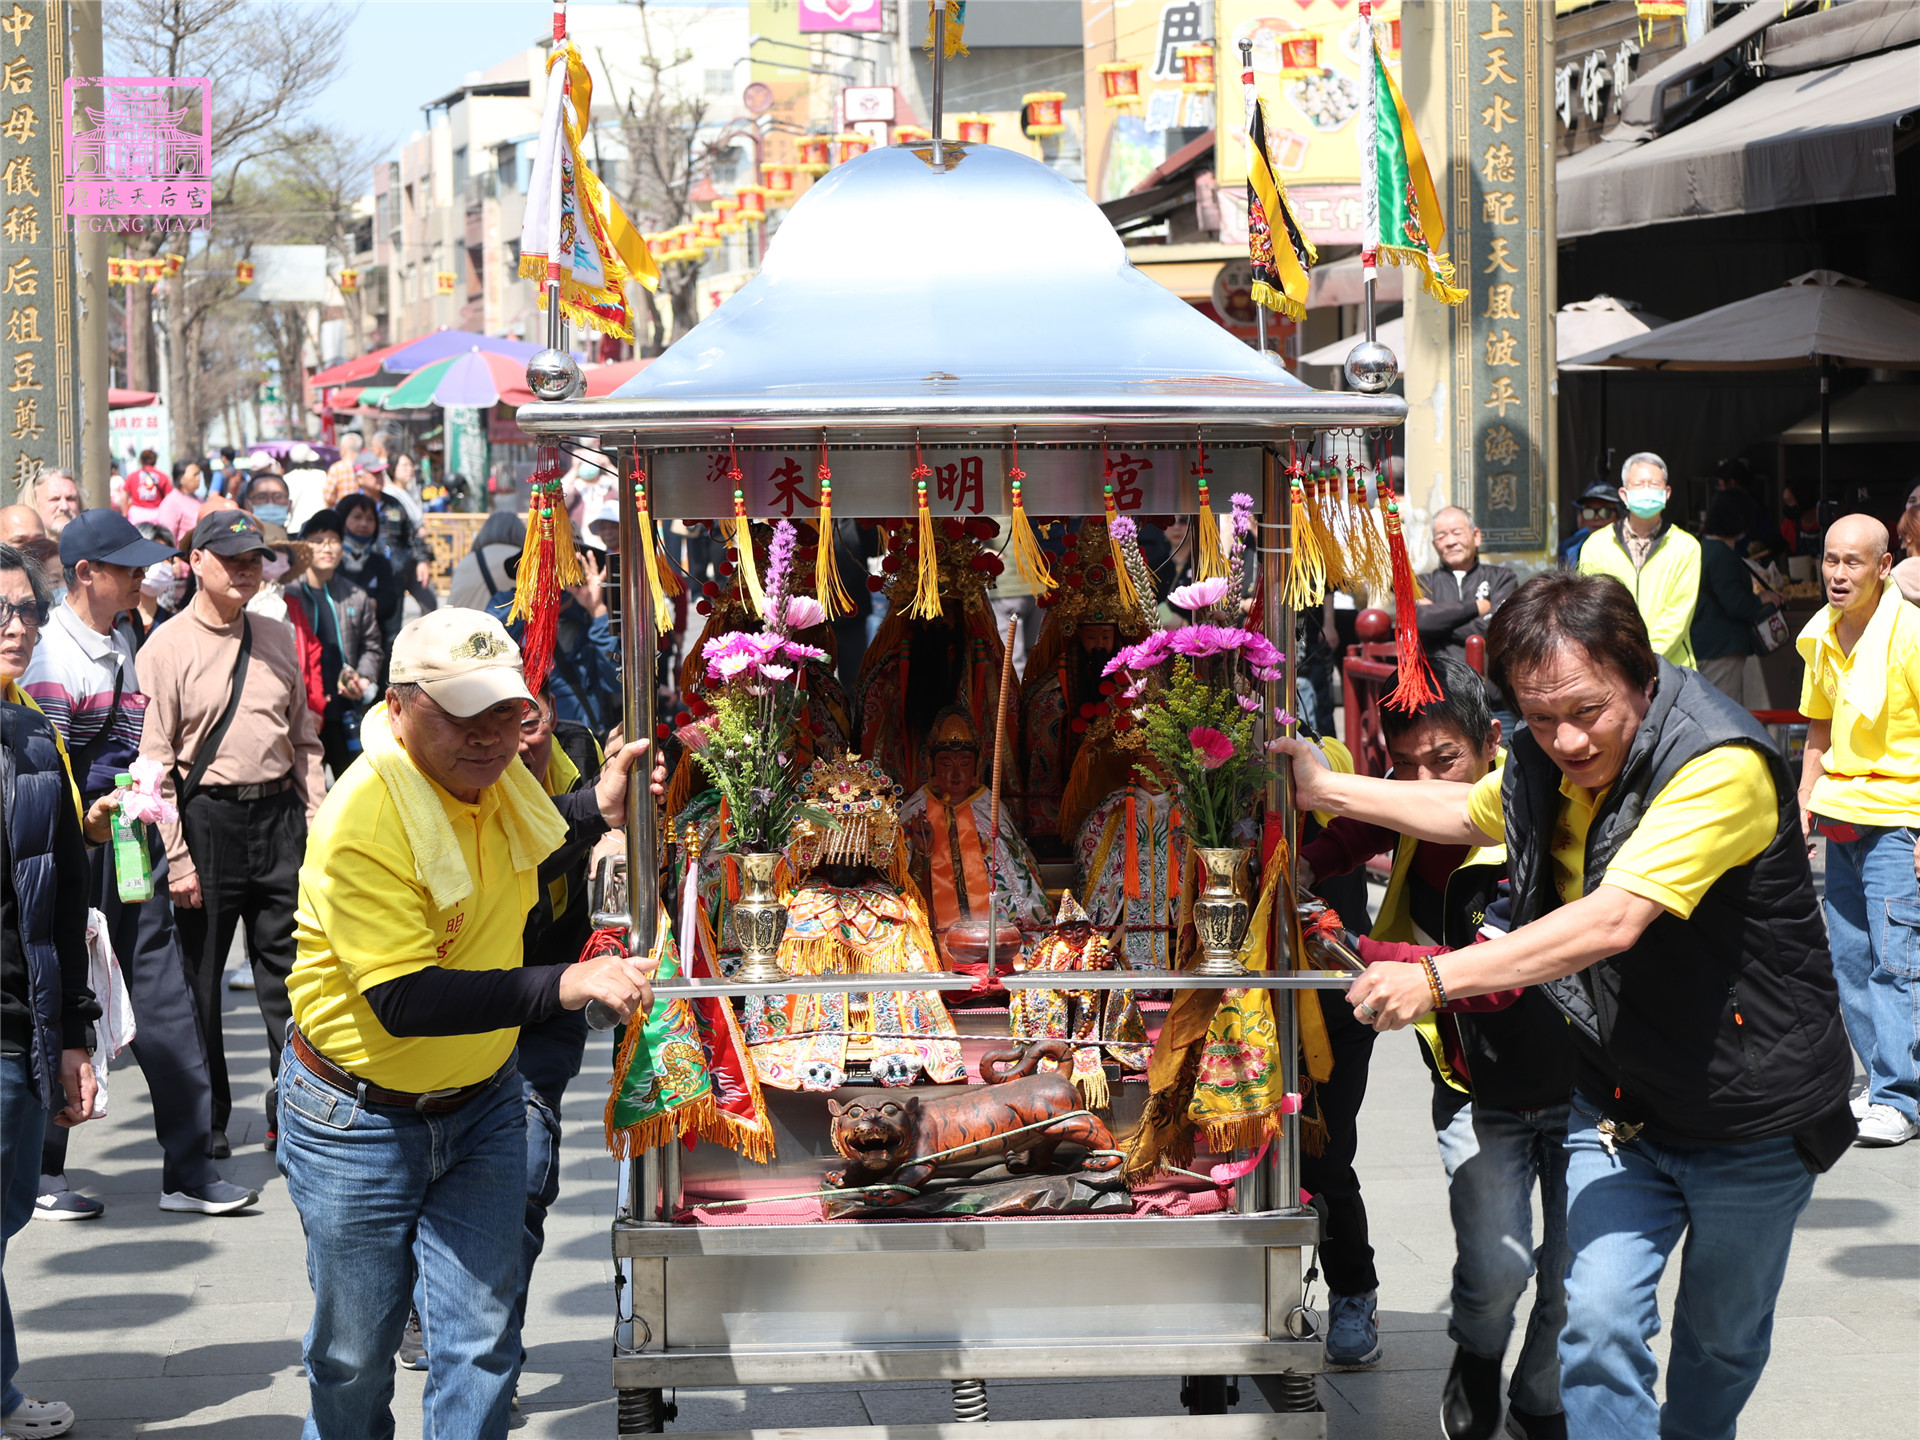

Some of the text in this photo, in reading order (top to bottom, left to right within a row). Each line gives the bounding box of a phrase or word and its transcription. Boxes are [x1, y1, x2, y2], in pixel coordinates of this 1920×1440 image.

[1479, 1, 1520, 511] 上天水德配天風波平海國
